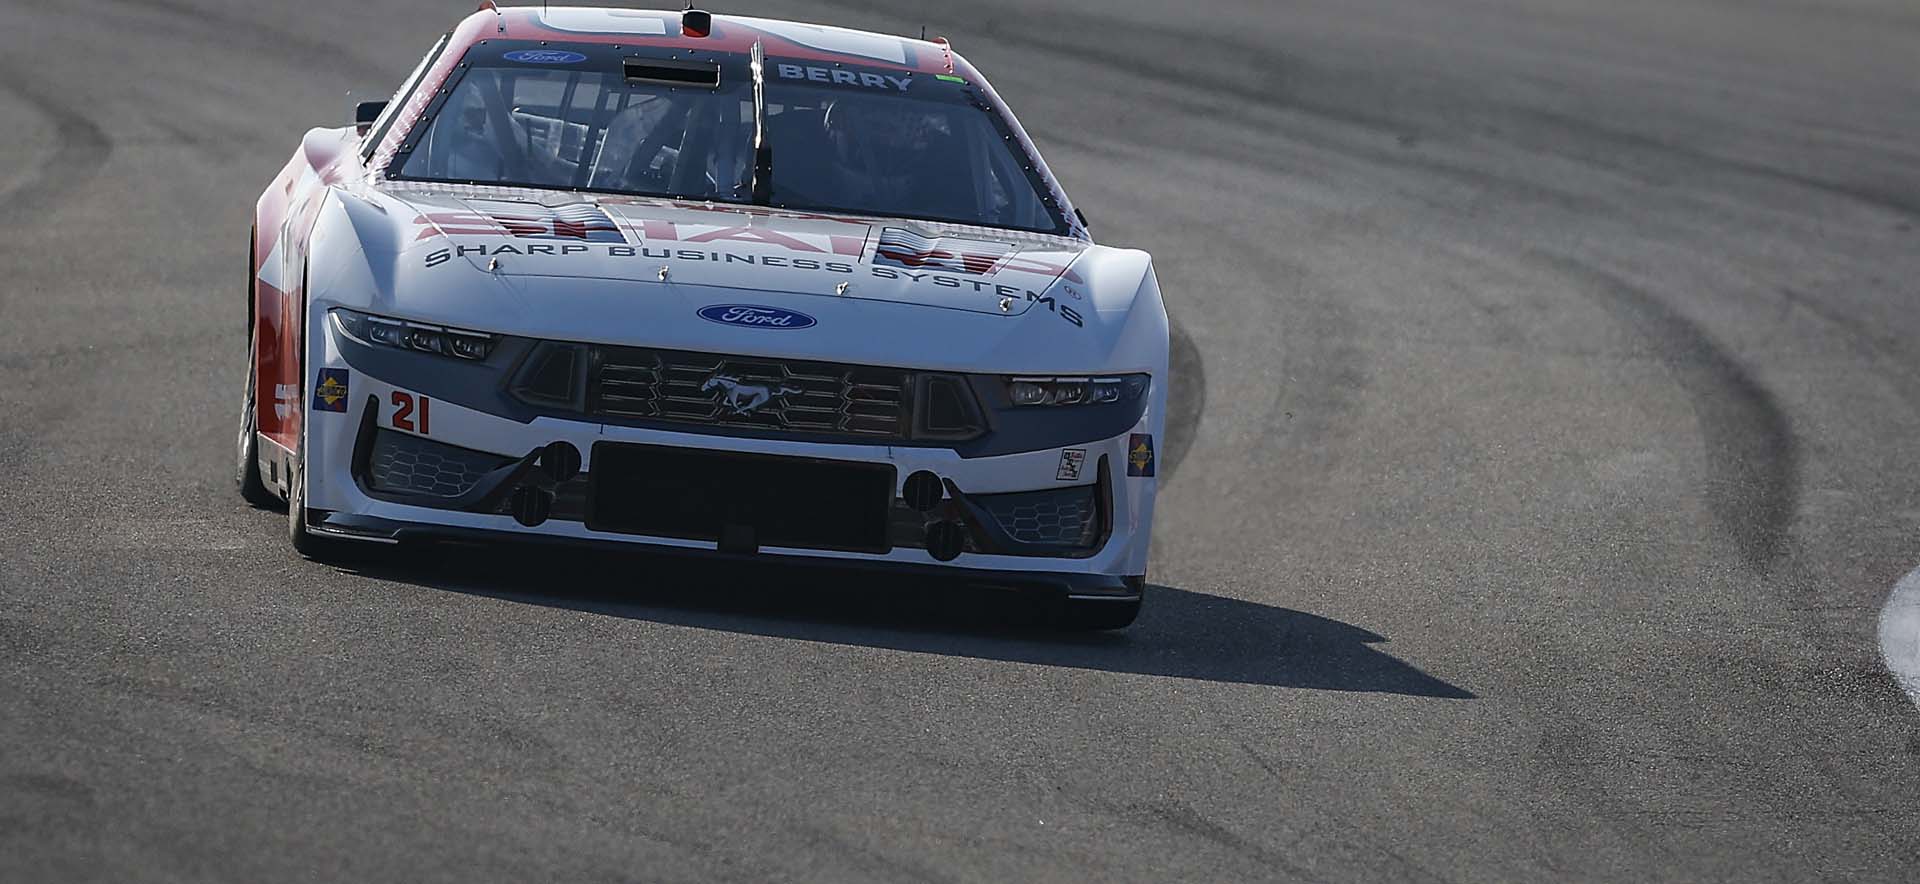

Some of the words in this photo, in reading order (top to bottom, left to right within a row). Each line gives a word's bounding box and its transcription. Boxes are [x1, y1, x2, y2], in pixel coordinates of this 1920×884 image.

[519, 51, 570, 62] Ford
[778, 64, 913, 91] BERRY
[425, 244, 589, 268] SHARP
[608, 246, 854, 273] BUSINESS
[870, 267, 1084, 328] SYSTEMS
[721, 306, 793, 326] Ford
[391, 391, 430, 435] 21
